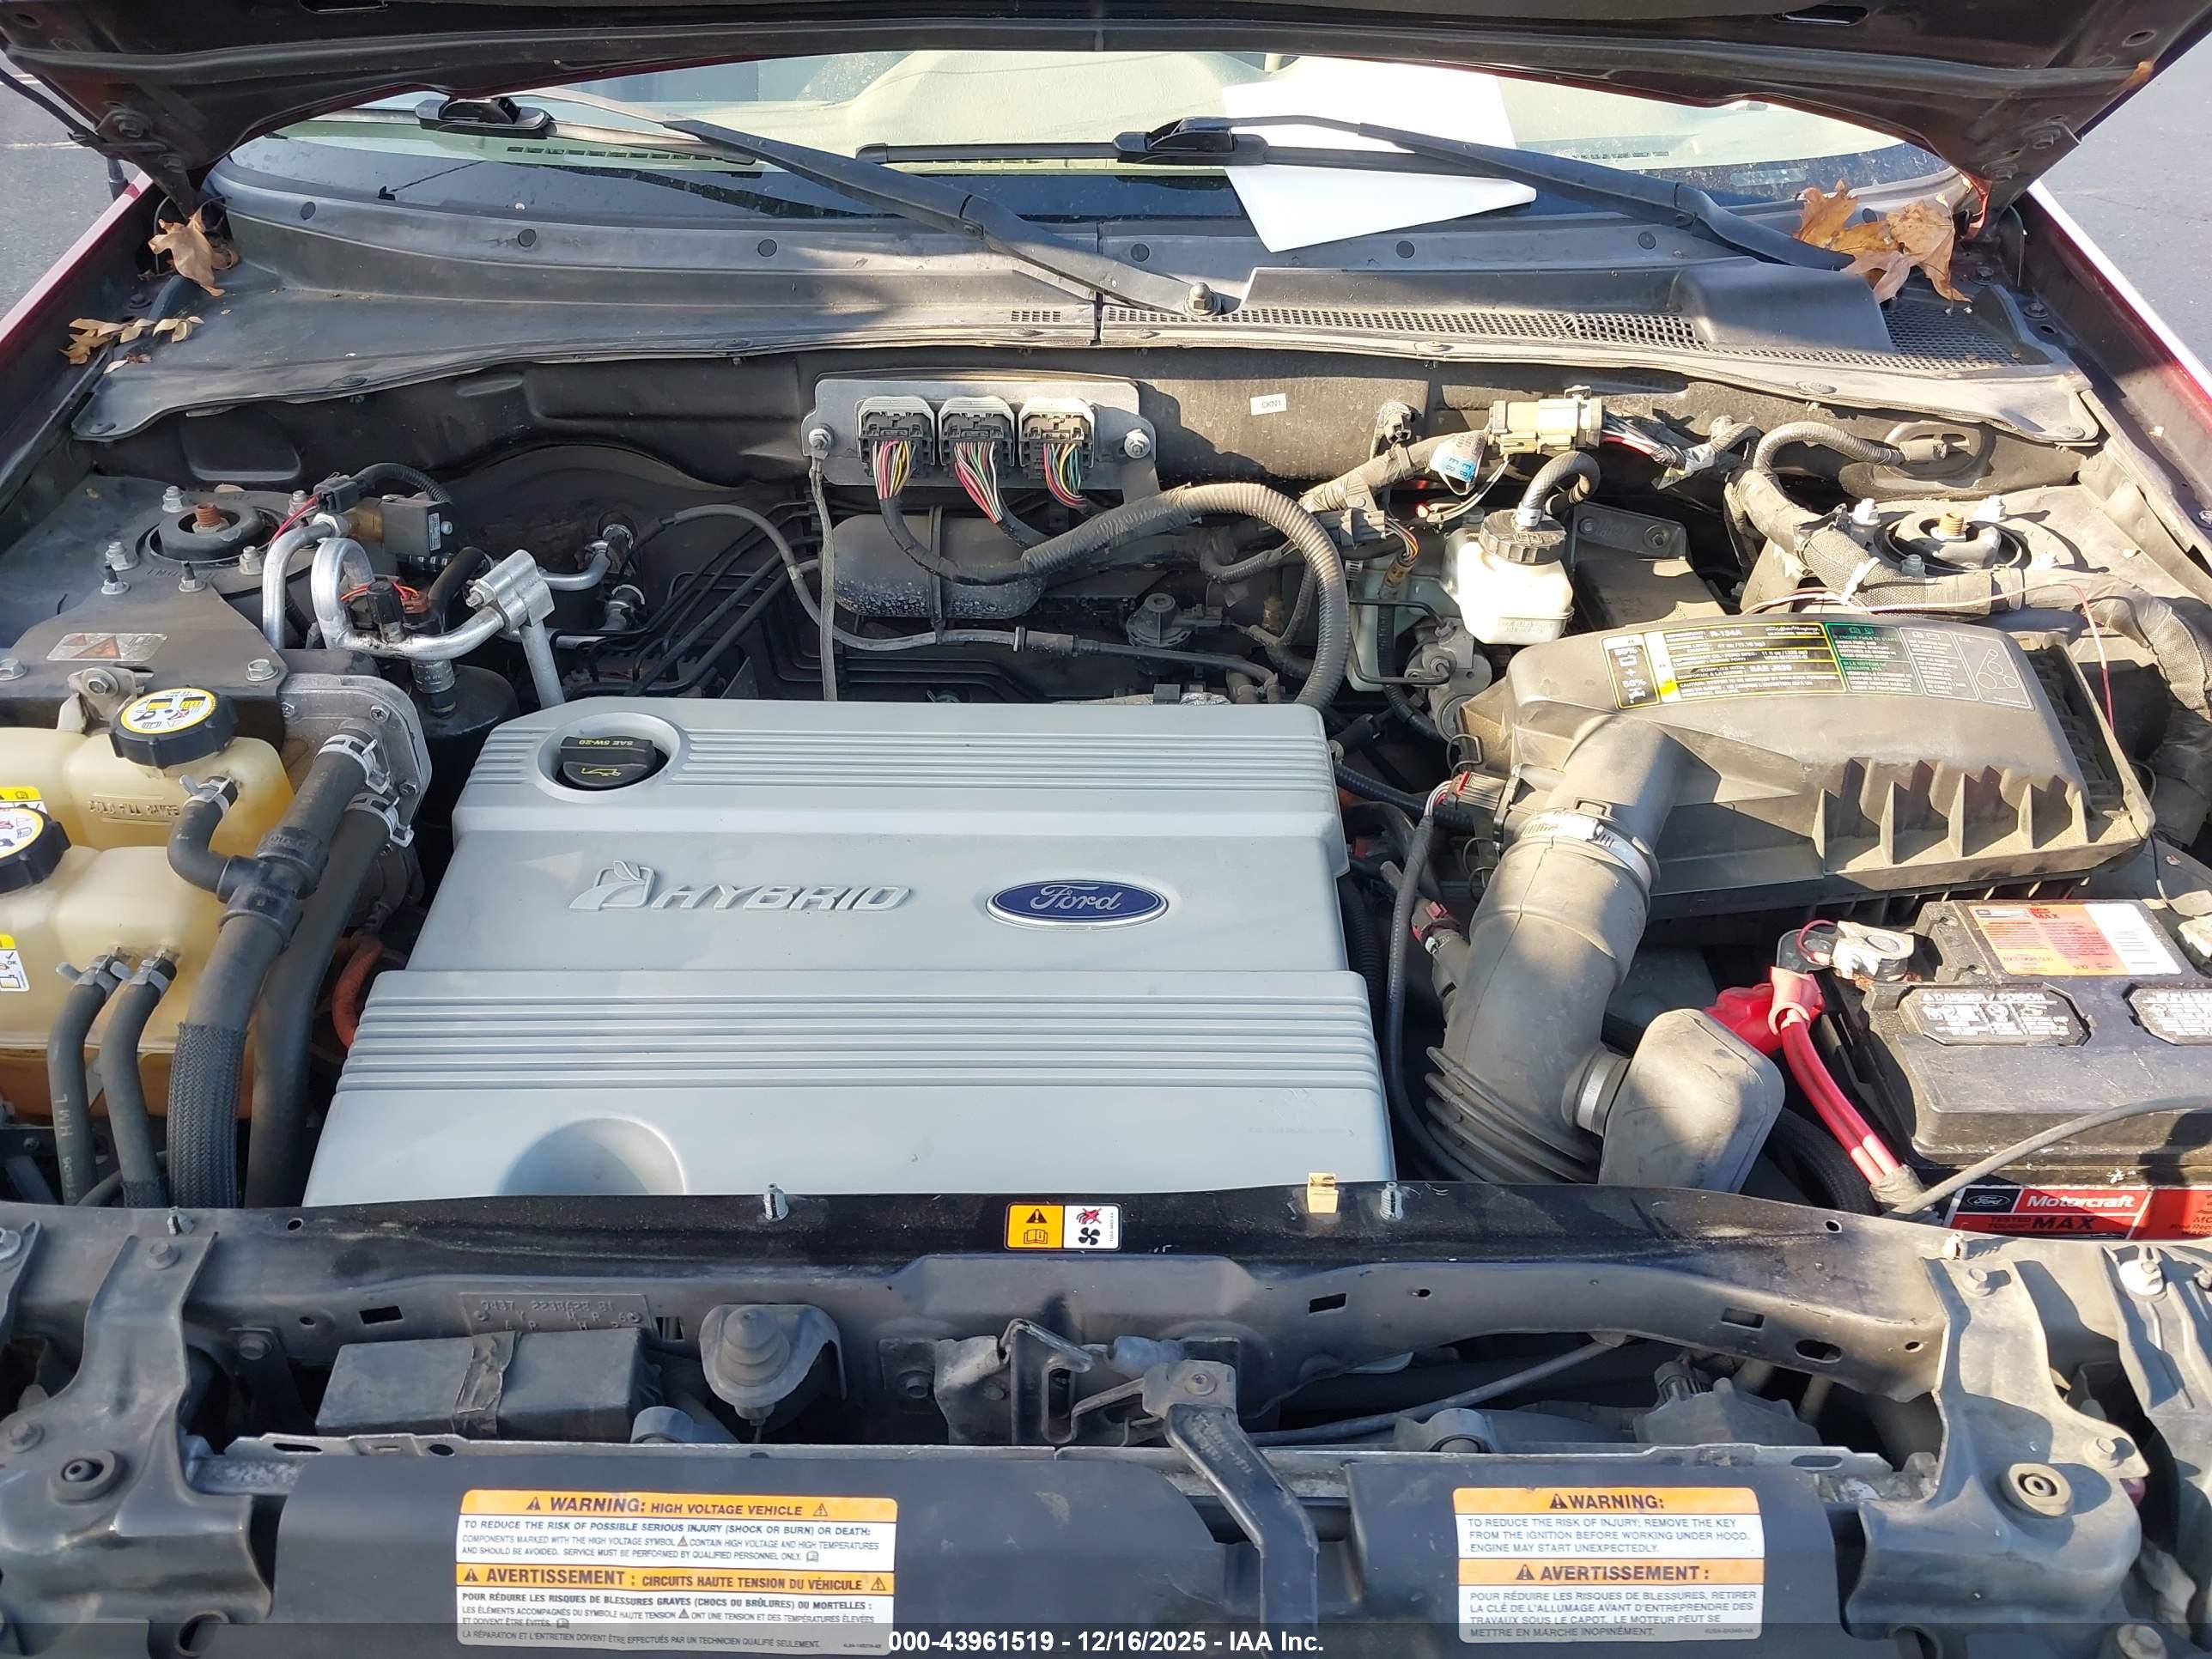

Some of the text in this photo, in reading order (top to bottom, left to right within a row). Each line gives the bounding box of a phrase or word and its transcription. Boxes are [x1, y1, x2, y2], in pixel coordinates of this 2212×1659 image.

[650, 884, 913, 910] HYBRID
[1030, 885, 1122, 910] Ford
[1933, 993, 1986, 1002] DANGER
[1998, 993, 2046, 1001] POISON
[1973, 1195, 2136, 1208] Ford Motorcraft
[2032, 1217, 2096, 1229] MAX
[550, 1497, 803, 1515] WARNING: HIGH VOLTAGE VEHICLE
[1568, 1495, 1664, 1509] WARNING:
[481, 1521, 521, 1529] REDUCE
[525, 1521, 543, 1529] THE
[548, 1522, 570, 1530] RISK
[590, 1522, 638, 1531] POSSIBLE
[642, 1523, 684, 1531] SERIOUS
[687, 1524, 721, 1533] INJURY
[726, 1525, 762, 1534] (SHOCK
[784, 1526, 814, 1534] BURN)
[835, 1527, 870, 1536] DEATH:
[1644, 1519, 1689, 1527] REMOVE
[1692, 1519, 1712, 1527] THE
[1716, 1519, 1736, 1527] KEY
[486, 1568, 862, 1590] AVERTISSEMENT : CIRCUITS HAUTE TENSION DU VÉHICULE
[1540, 1566, 1709, 1580] AVERTISSEMENT :
[462, 1593, 486, 1602] POUR
[489, 1592, 526, 1603] RÉDUIRE
[530, 1594, 545, 1603] LES
[549, 1595, 586, 1604] RISQUES
[590, 1596, 600, 1604] DE
[604, 1596, 653, 1605] BLESSURES
[657, 1597, 691, 1606] GRAVES
[695, 1598, 727, 1607] (CHOCS
[731, 1599, 742, 1608] OU
[798, 1600, 809, 1609] OU
[813, 1601, 865, 1610] MORTELLES
[1711, 1591, 1757, 1599] RETIRER
[1630, 1616, 1675, 1624] MOTEUR
